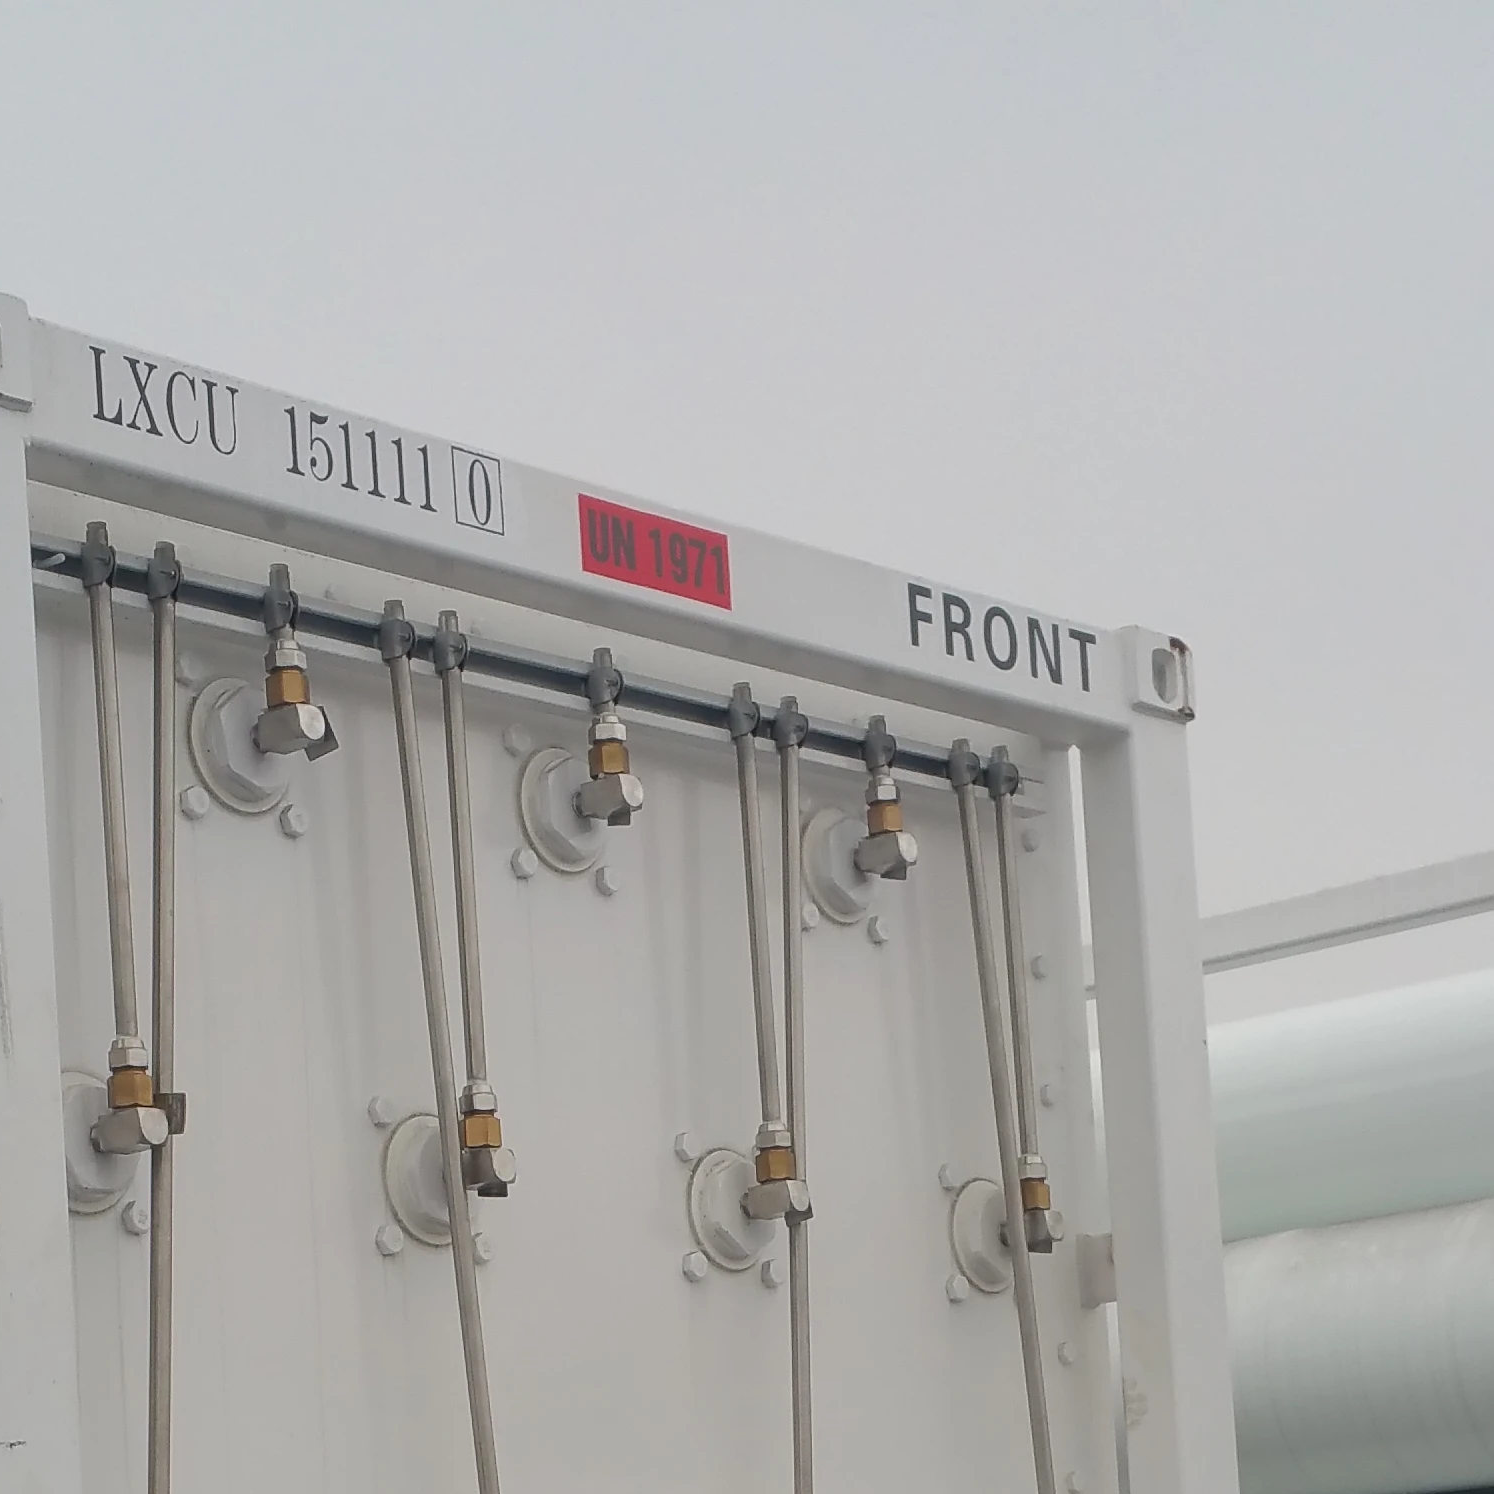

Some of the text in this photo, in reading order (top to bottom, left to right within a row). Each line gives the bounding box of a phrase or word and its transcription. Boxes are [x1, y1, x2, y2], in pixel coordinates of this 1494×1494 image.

[88, 345, 239, 455] LXCU
[283, 406, 437, 512] 151111
[587, 508, 726, 596] UN 1971
[907, 582, 1096, 693] FRONT
